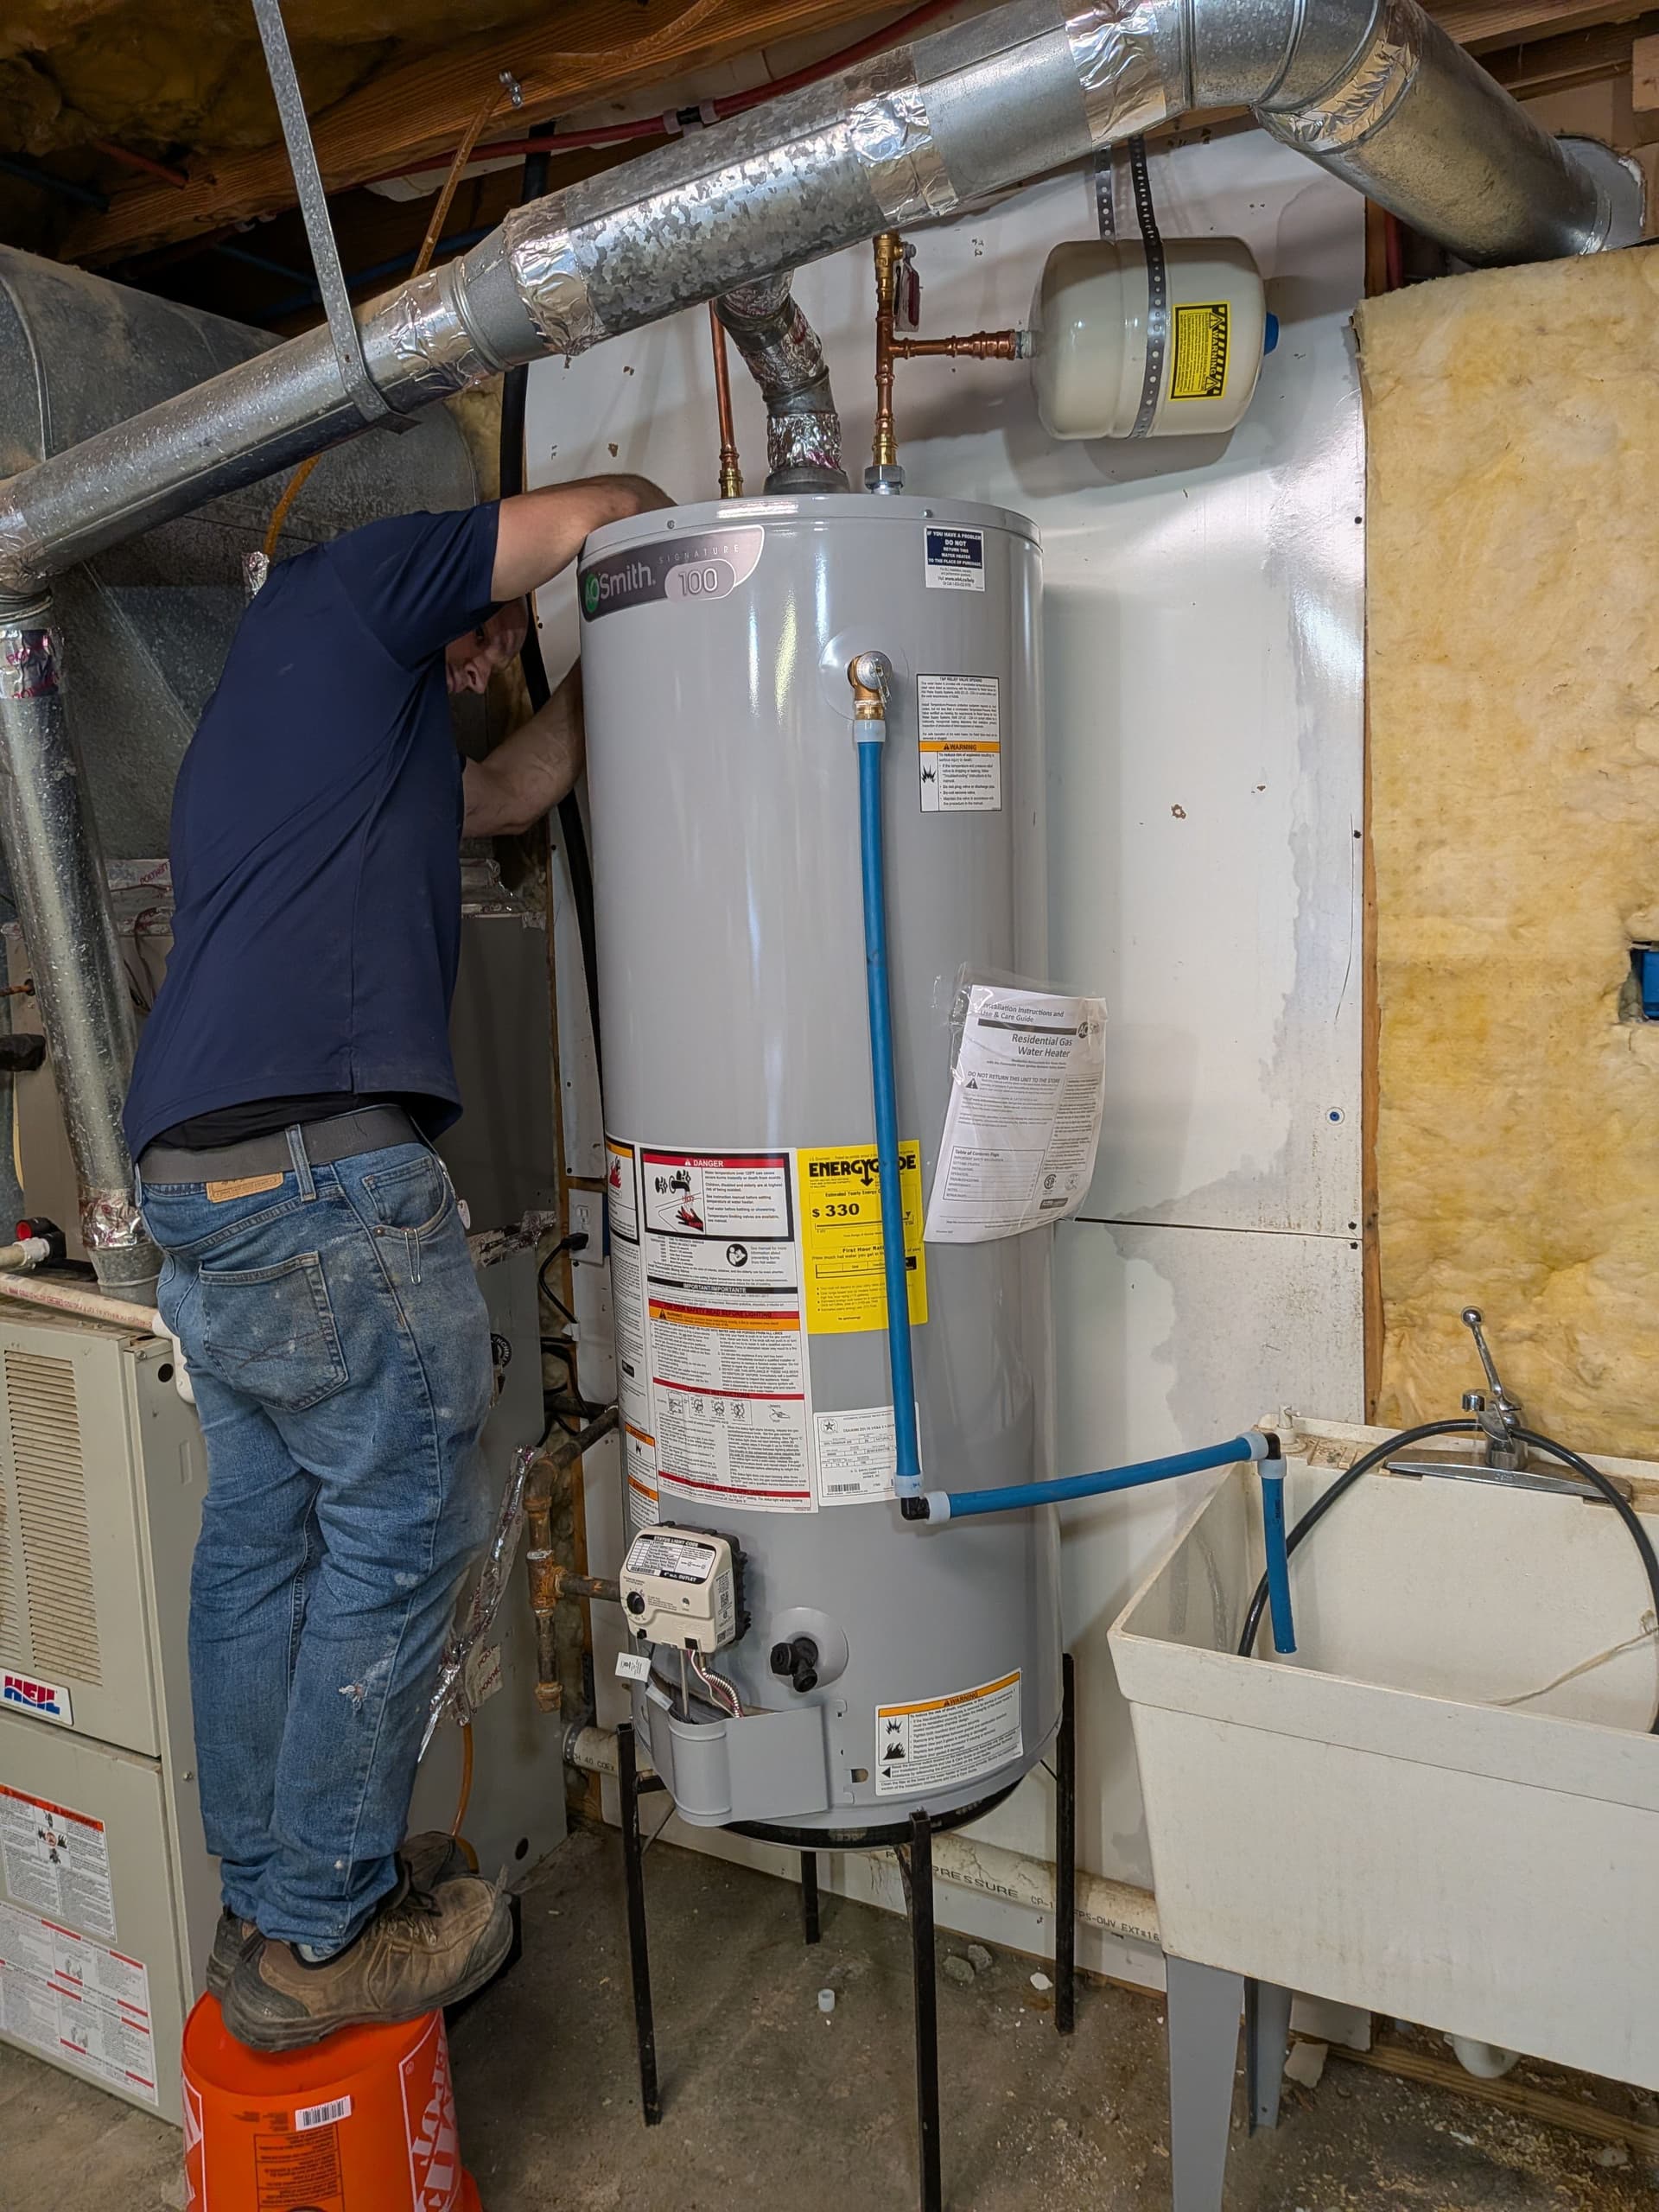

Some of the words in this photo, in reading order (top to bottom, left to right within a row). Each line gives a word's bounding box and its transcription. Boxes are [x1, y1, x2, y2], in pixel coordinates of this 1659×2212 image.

[1210, 330, 1218, 375] WARNING
[658, 544, 740, 564] SIGNATURE
[678, 568, 718, 596] 100
[1016, 1014, 1034, 1023] Guide
[1018, 1006, 1052, 1016] Instructions
[1012, 1033, 1058, 1046] Residential
[1059, 1037, 1072, 1046] Gas
[1018, 1046, 1043, 1056] Water
[1045, 1048, 1071, 1058] Heater
[809, 1154, 916, 1179] ENERGYGDE
[812, 1208, 820, 1218] $
[825, 1203, 860, 1217] 330
[4, 1675, 60, 1715] HEIL
[949, 1691, 978, 1706] WARNING
[933, 1866, 1018, 1898] PRESSURE
